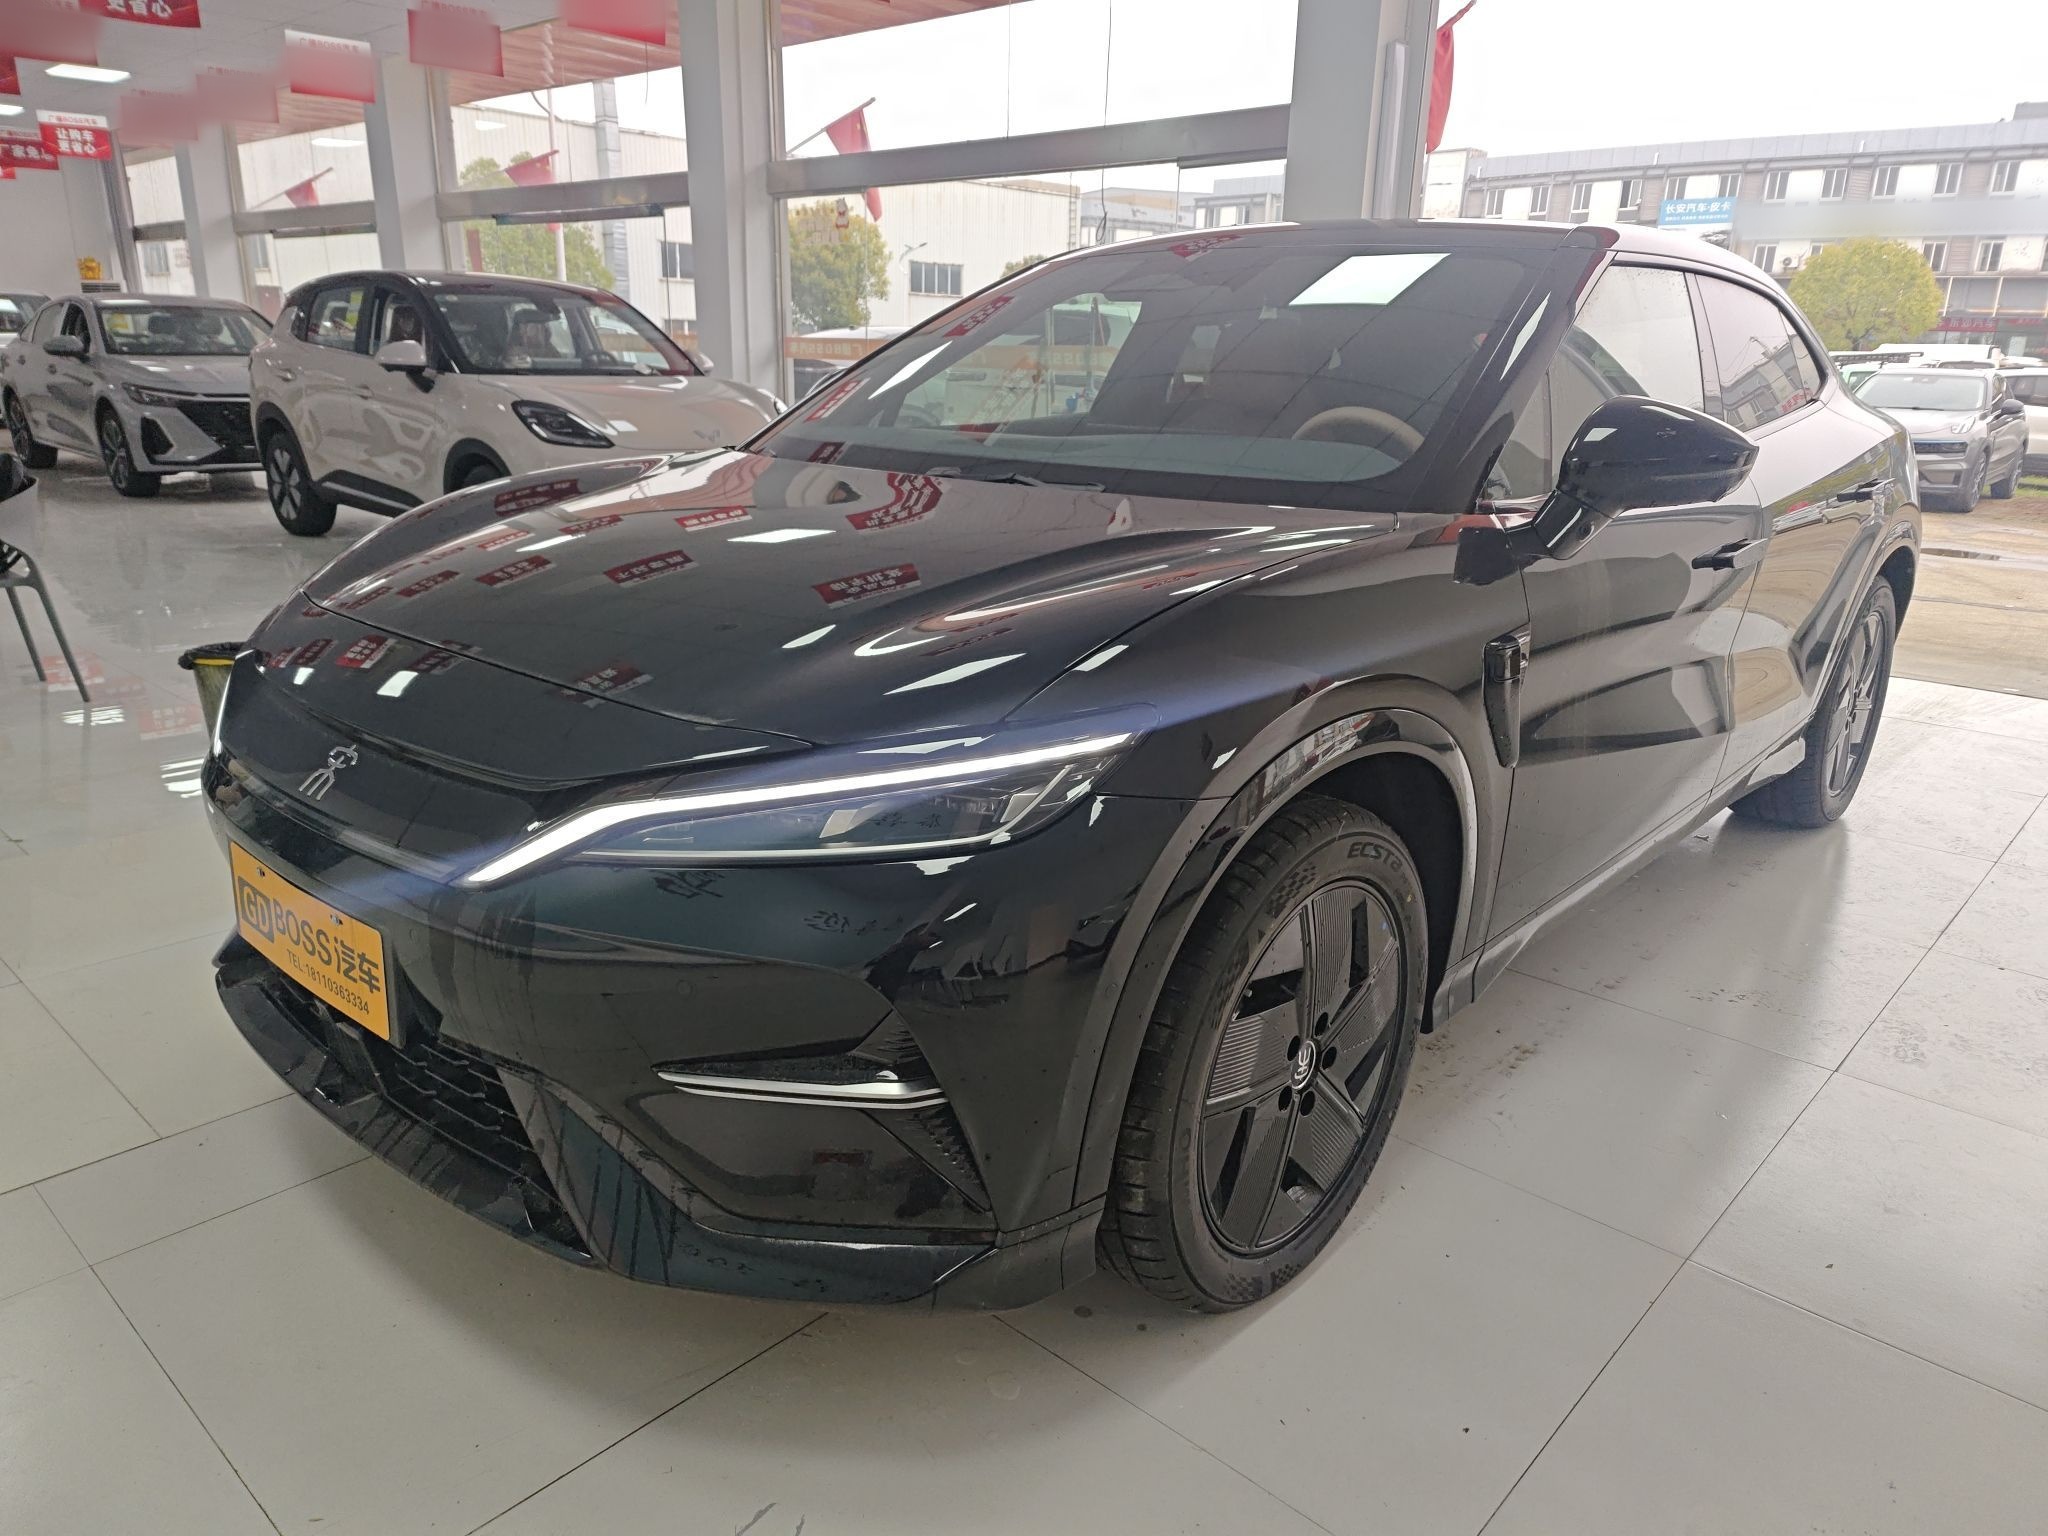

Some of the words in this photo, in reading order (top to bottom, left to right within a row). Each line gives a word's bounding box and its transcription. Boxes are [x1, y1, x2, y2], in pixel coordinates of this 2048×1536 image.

[56, 127, 95, 143] 让购车
[58, 139, 97, 154] 更省心
[242, 882, 271, 938] GD
[273, 898, 381, 994] BOSS汽车
